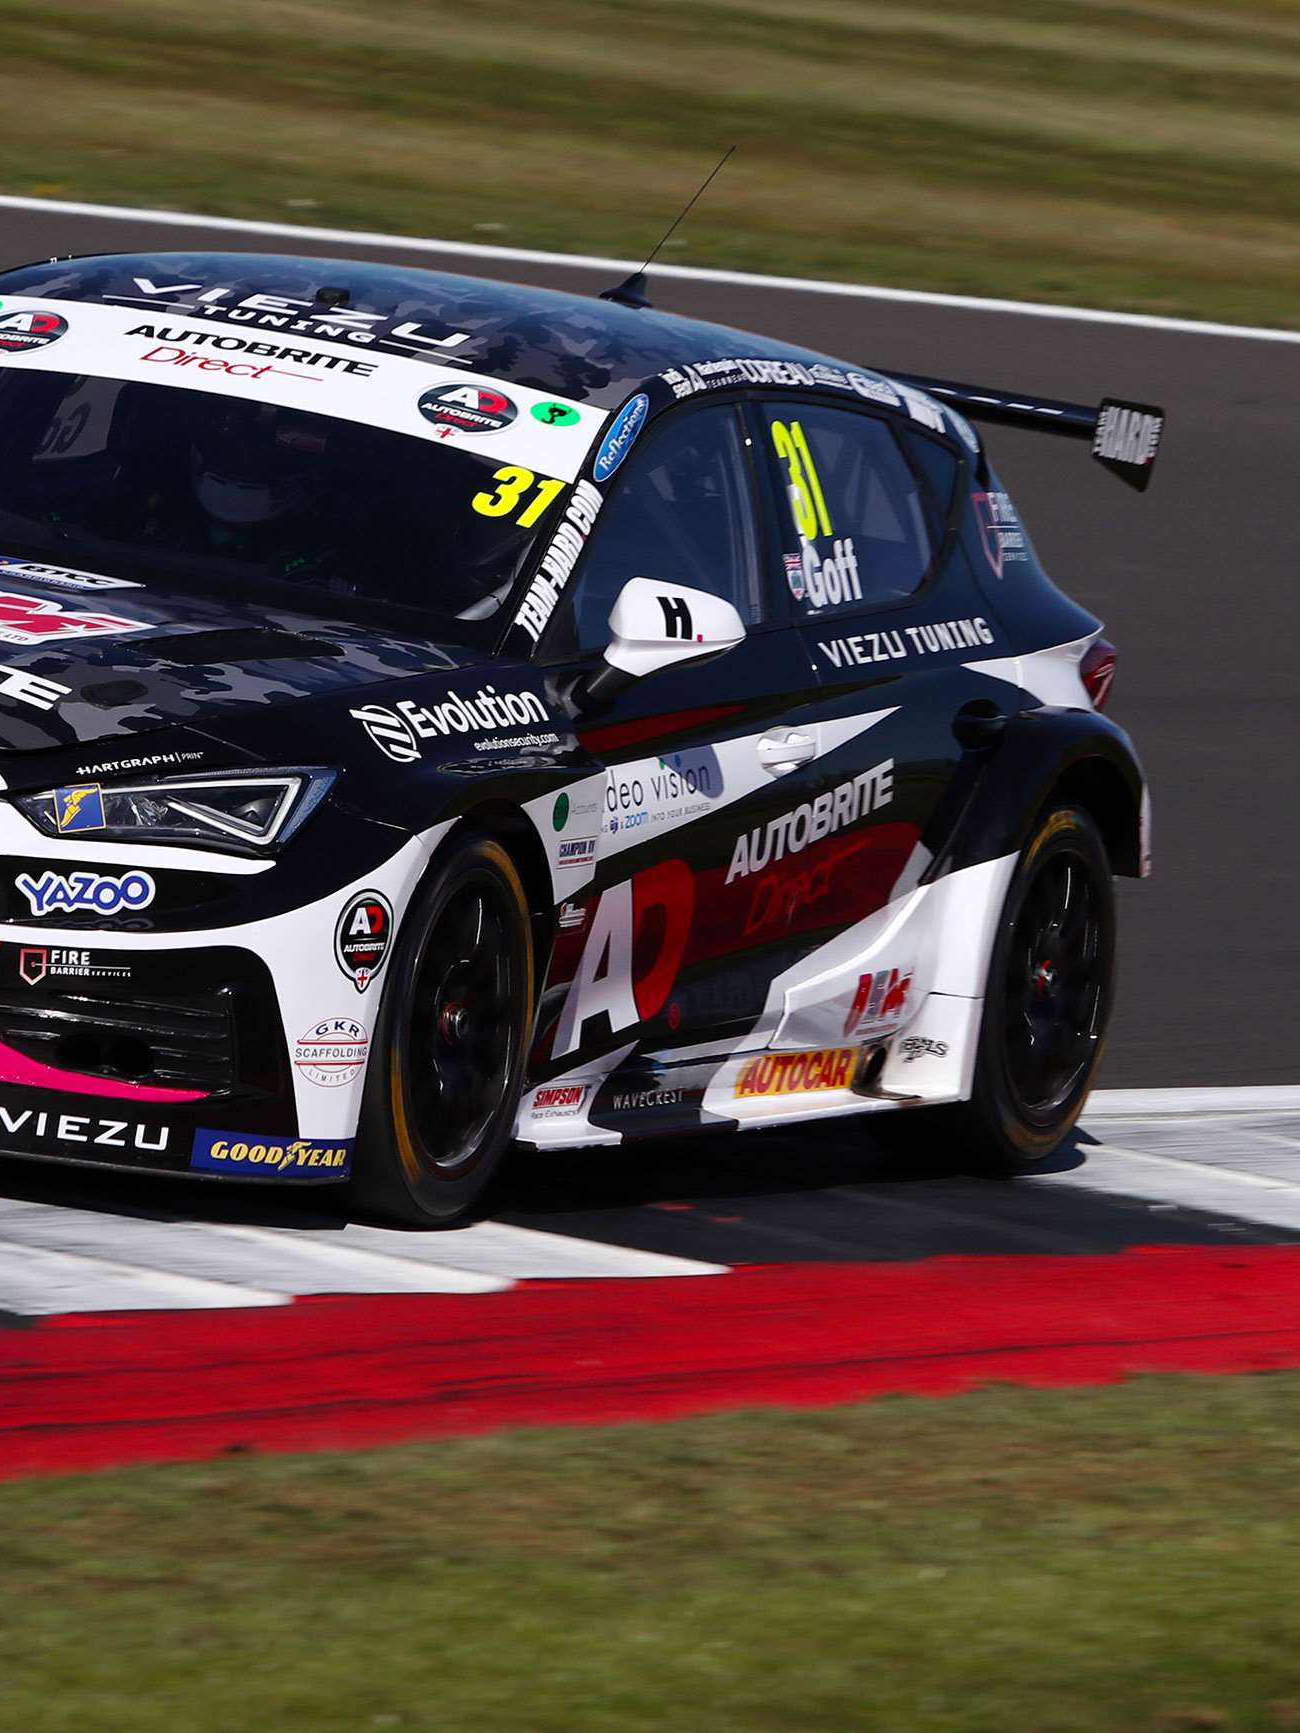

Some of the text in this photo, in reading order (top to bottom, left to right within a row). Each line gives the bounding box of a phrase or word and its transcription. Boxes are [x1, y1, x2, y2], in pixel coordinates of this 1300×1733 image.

[133, 277, 473, 348] VIEZU
[203, 305, 382, 343] TUNING
[124, 324, 379, 378] AUTOBRITE
[140, 346, 324, 381] Direct
[420, 402, 503, 428] AUTOBRITE
[599, 397, 649, 471] Reflections
[771, 420, 834, 541] 31
[471, 466, 565, 529] 31
[803, 537, 863, 608] Goff
[4, 631, 29, 642] LTD
[817, 617, 995, 667] VIEZU TUNING
[396, 685, 550, 738] Evolution
[473, 732, 560, 751] evolutionsecurity.com
[76, 753, 176, 775] HARTGRAPH
[651, 754, 711, 800] vision
[624, 810, 650, 829] zoom
[724, 758, 895, 886] AUTOBRITE
[15, 870, 156, 916] YAZOO
[50, 949, 91, 966] FIRE
[343, 942, 386, 953] AUTOBRITE
[50, 966, 90, 977] BARRIER
[315, 1020, 360, 1038] GKR
[294, 1046, 368, 1058] SCAFFOLDING
[308, 1068, 356, 1082] LIMITED
[739, 1049, 851, 1095] AUTOCAR
[533, 1086, 584, 1107] SIMPSON
[612, 1087, 685, 1110] WAVECREST
[210, 1140, 348, 1171] GOODYEAR
